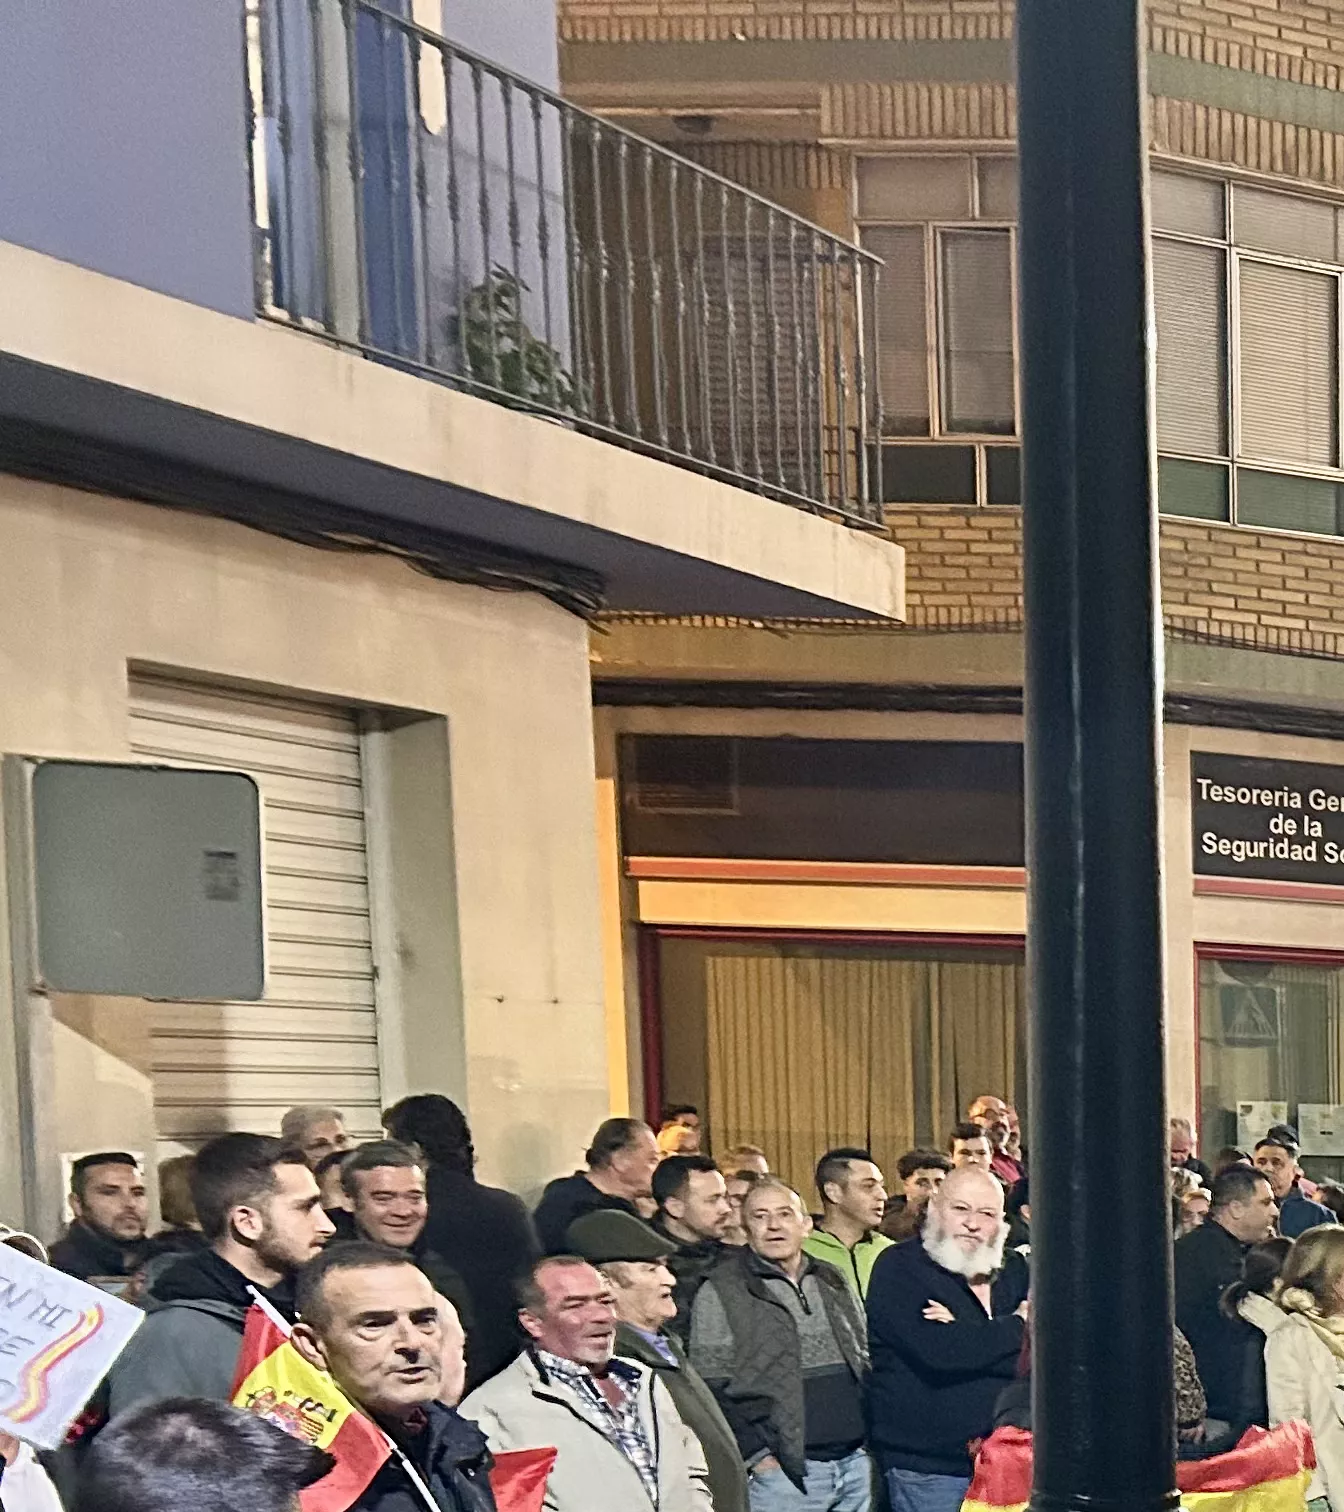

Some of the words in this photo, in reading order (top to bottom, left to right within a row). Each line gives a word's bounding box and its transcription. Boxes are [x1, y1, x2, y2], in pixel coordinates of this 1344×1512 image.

[1196, 778, 1302, 808] Tesoreria
[1269, 813, 1297, 835] de
[1303, 815, 1323, 837] la
[1201, 832, 1317, 862] Seguridad
